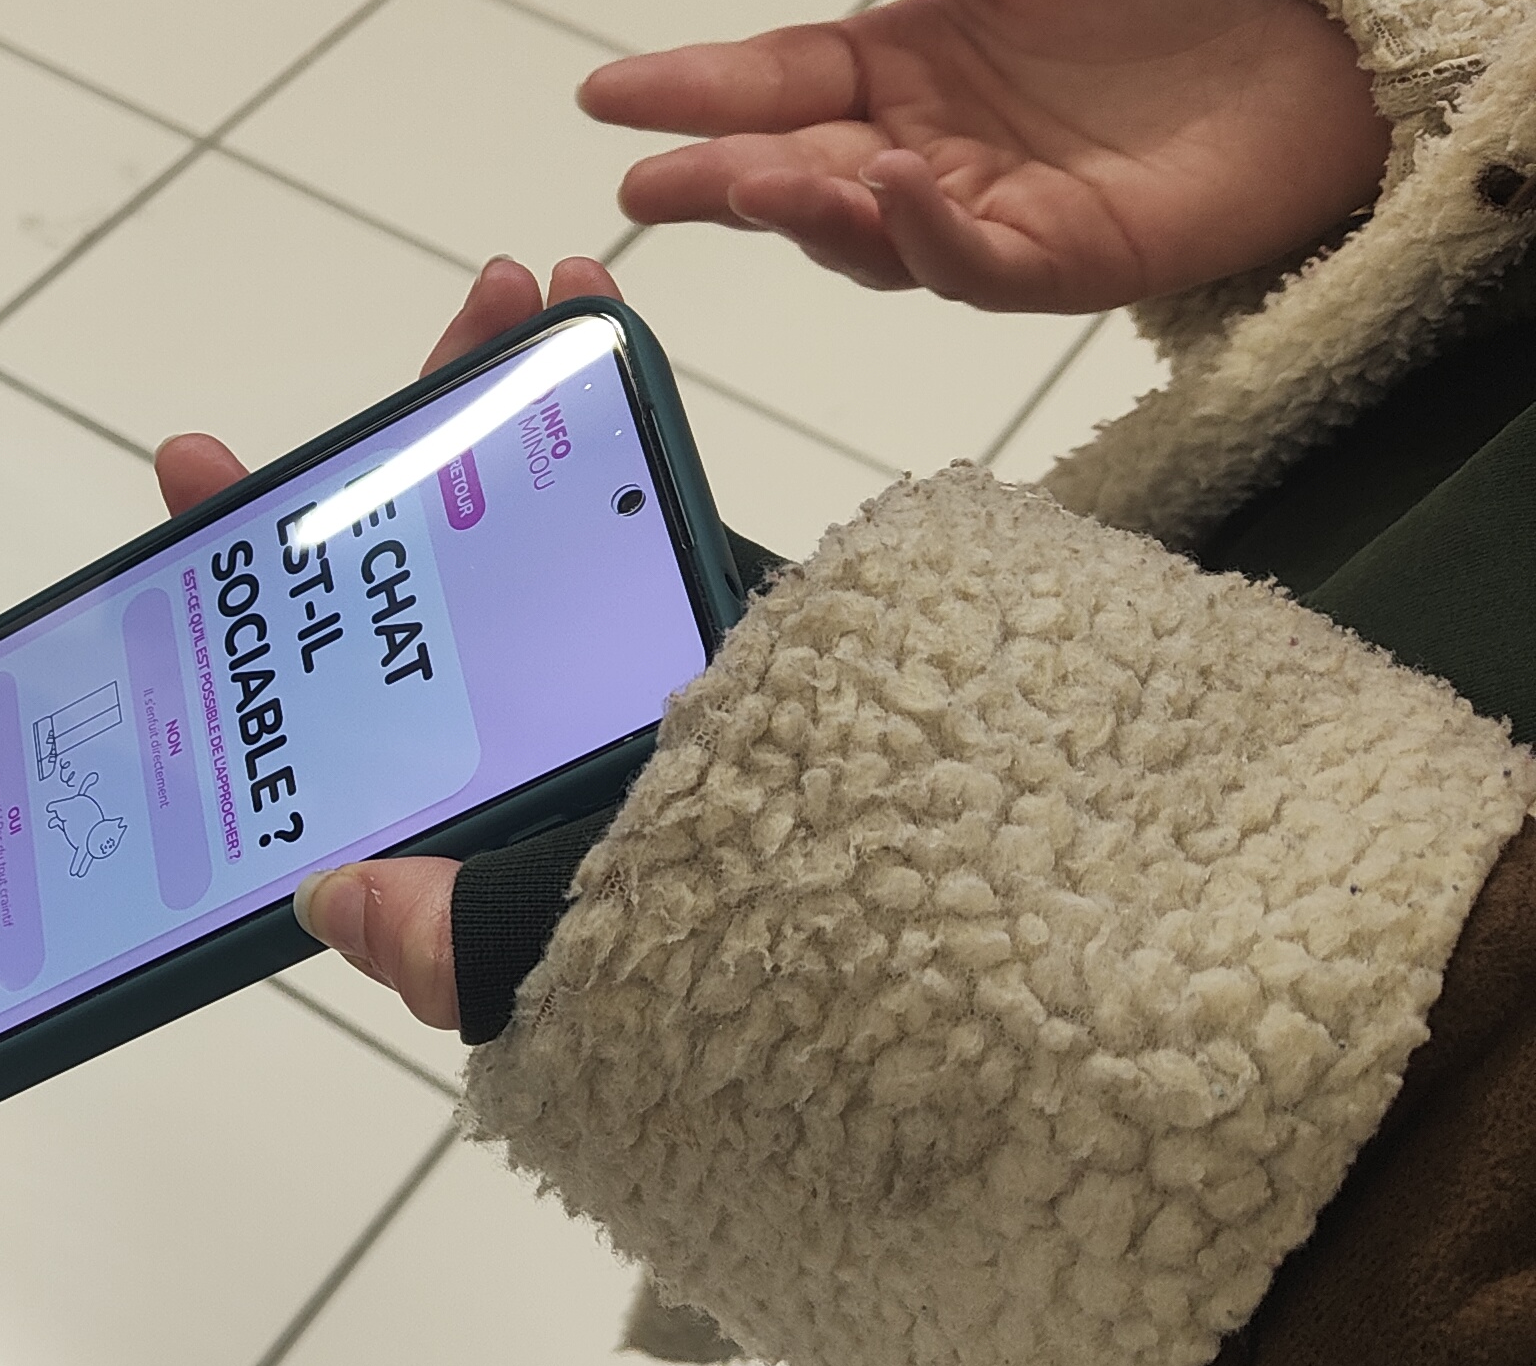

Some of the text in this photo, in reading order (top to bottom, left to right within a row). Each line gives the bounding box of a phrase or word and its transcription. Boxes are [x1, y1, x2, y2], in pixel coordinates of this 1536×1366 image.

[518, 414, 555, 490] MINOU
[539, 402, 571, 460] INFO
[361, 539, 433, 685] CHAT
[144, 697, 160, 739] s'enfuit
[183, 568, 242, 860] EST-CE QU'IL EST POSSIBLE DE L'APPROCHER ?
[211, 540, 304, 848] SOCIABLE ?
[165, 718, 183, 757] NON
[150, 739, 170, 810] directement
[7, 806, 22, 836] OUI
[0, 887, 15, 927] craintif
